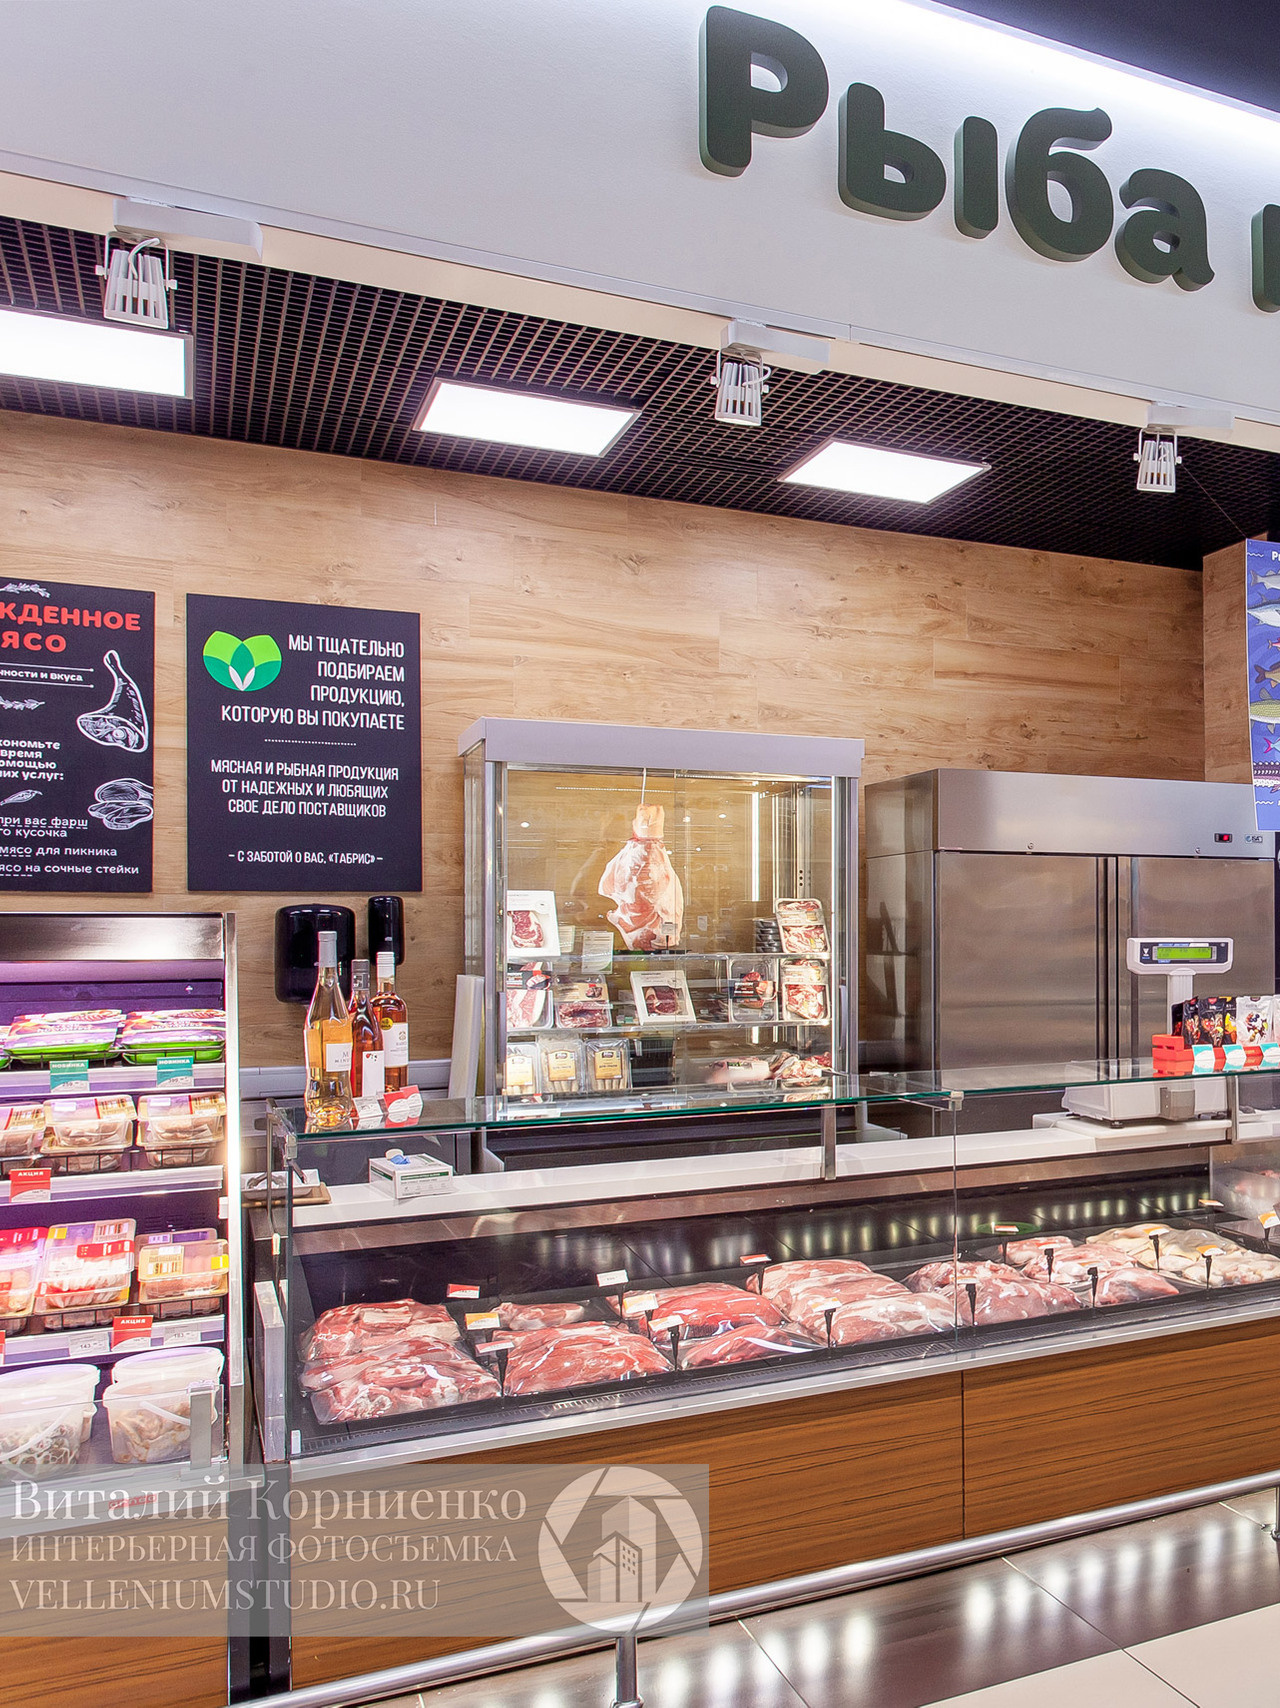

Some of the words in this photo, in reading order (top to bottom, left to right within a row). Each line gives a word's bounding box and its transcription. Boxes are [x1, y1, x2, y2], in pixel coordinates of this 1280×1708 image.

[698, 3, 1215, 293] Рыба
[288, 633, 313, 651] МЫ
[315, 635, 405, 659] ТЩАТЕЛЬНО
[40, 671, 48, 680] и
[49, 672, 84, 682] вкуса
[317, 660, 405, 682] ПОДБИРАЕМ
[310, 684, 406, 708] ПРОДУКЦИЮ,
[221, 704, 294, 725] КОТОРУЮ
[297, 708, 319, 726] ВЫ
[322, 709, 405, 731] ПОКУПАЕТЕ
[1, 749, 43, 760] время
[22, 770, 64, 782] услуг:
[211, 759, 262, 775] МЯСНАЯ
[264, 761, 274, 775] И
[276, 762, 326, 778] РЫБНАЯ
[328, 764, 399, 782] ПРОДУКЦИЯ
[221, 778, 238, 793] ОТ
[241, 779, 314, 797] НАДЕЖНЫХ
[316, 783, 325, 796] И
[327, 783, 389, 799] ЛЮБЯЩИХ
[228, 799, 259, 814] СВОЕ
[262, 800, 296, 815] ДЕЛО
[298, 801, 387, 818] ПОСТАВЩИКОВ
[24, 816, 47, 826] вас
[51, 816, 88, 829] фарш
[15, 829, 68, 839] кусочка
[0, 846, 32, 855] мясо
[36, 847, 61, 857] для
[64, 847, 118, 857] пикника
[237, 850, 245, 862] С
[246, 849, 293, 863] ЗАБОТОЙ
[294, 851, 302, 863] О
[328, 851, 376, 864] «ТАБРИС»
[25, 863, 41, 873] на
[44, 865, 93, 875] сочные
[95, 863, 140, 875] стейки
